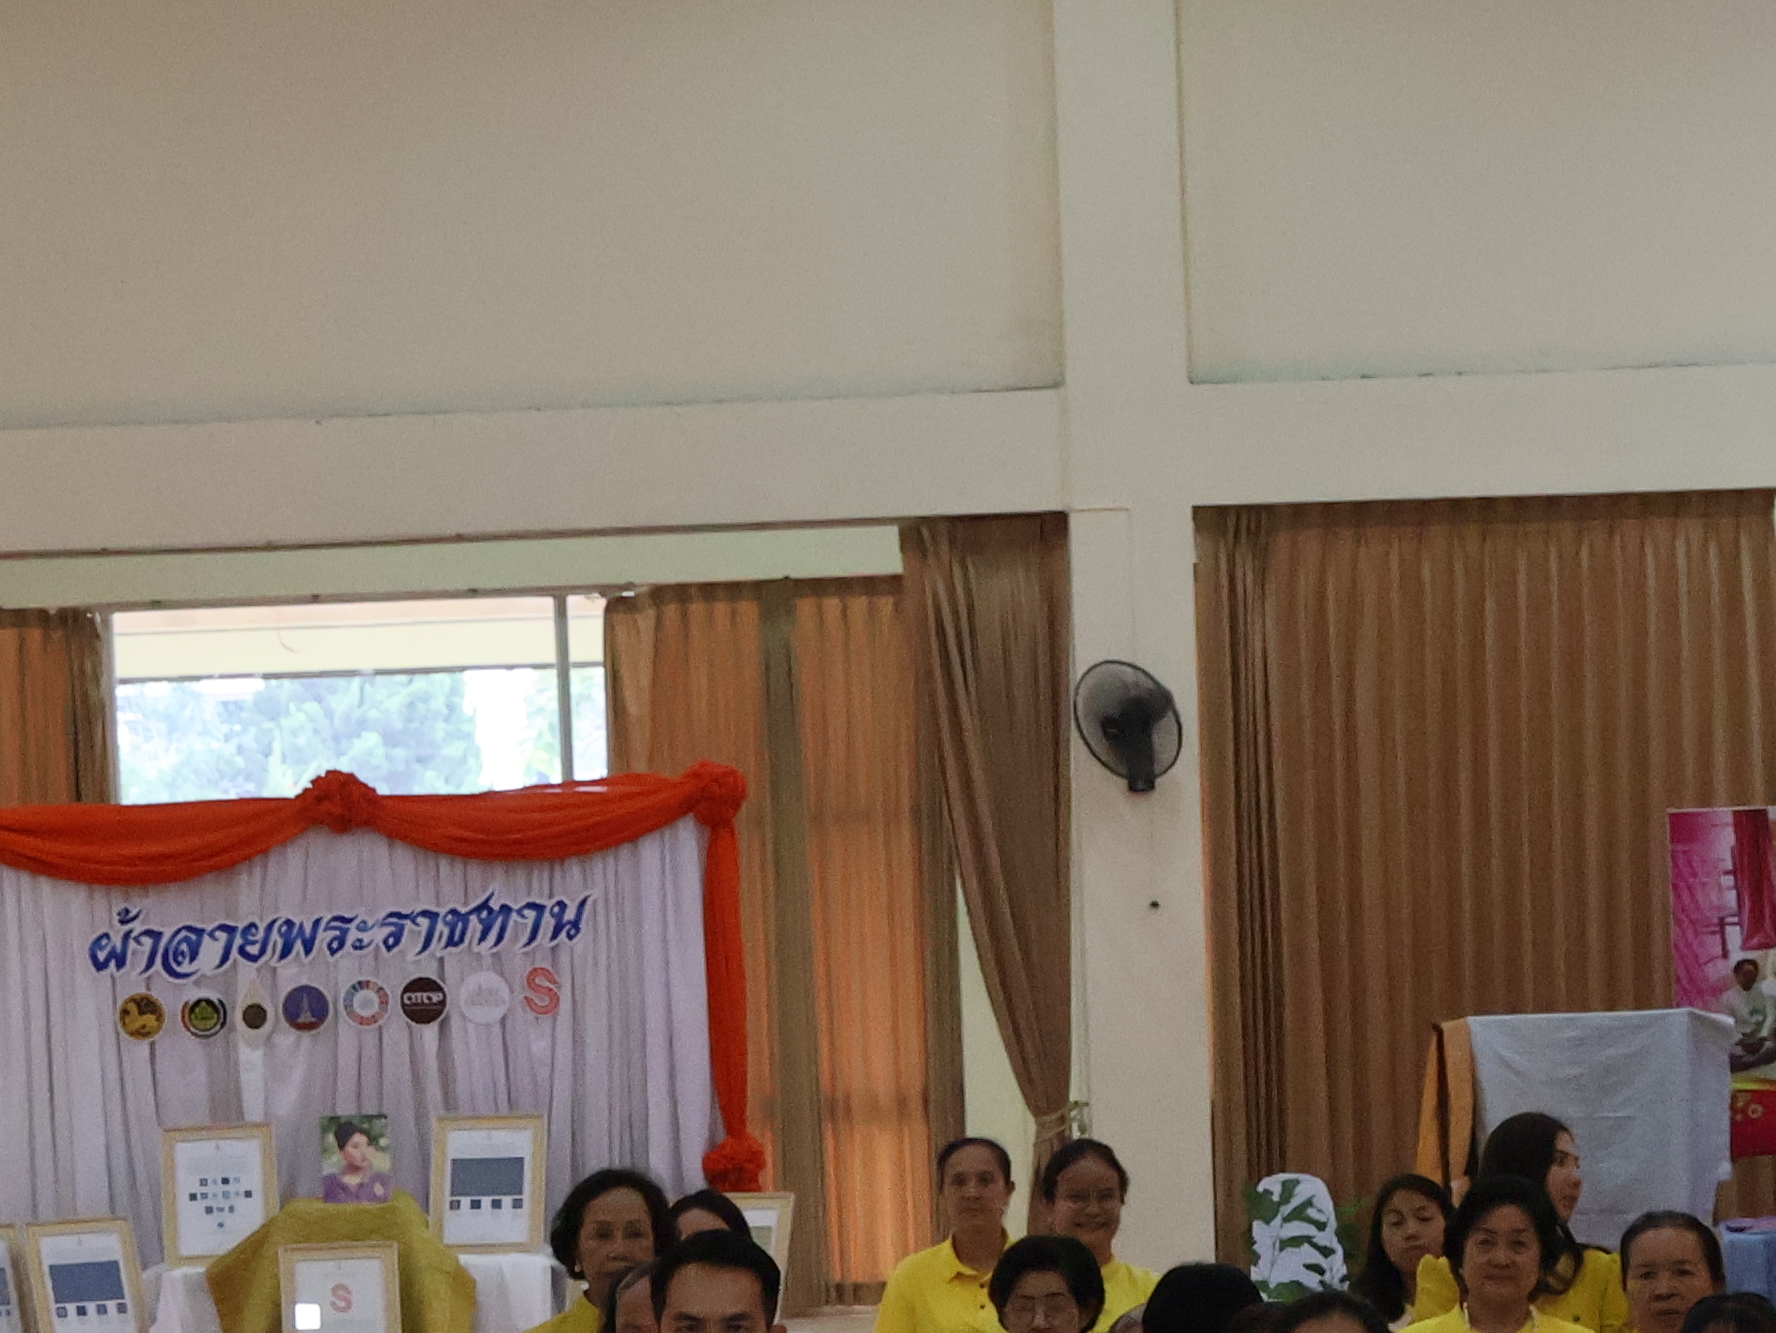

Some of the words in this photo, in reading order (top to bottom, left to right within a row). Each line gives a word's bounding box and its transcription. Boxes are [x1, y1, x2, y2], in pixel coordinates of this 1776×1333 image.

[88, 891, 591, 978] ผ้าลายพระราชทาน
